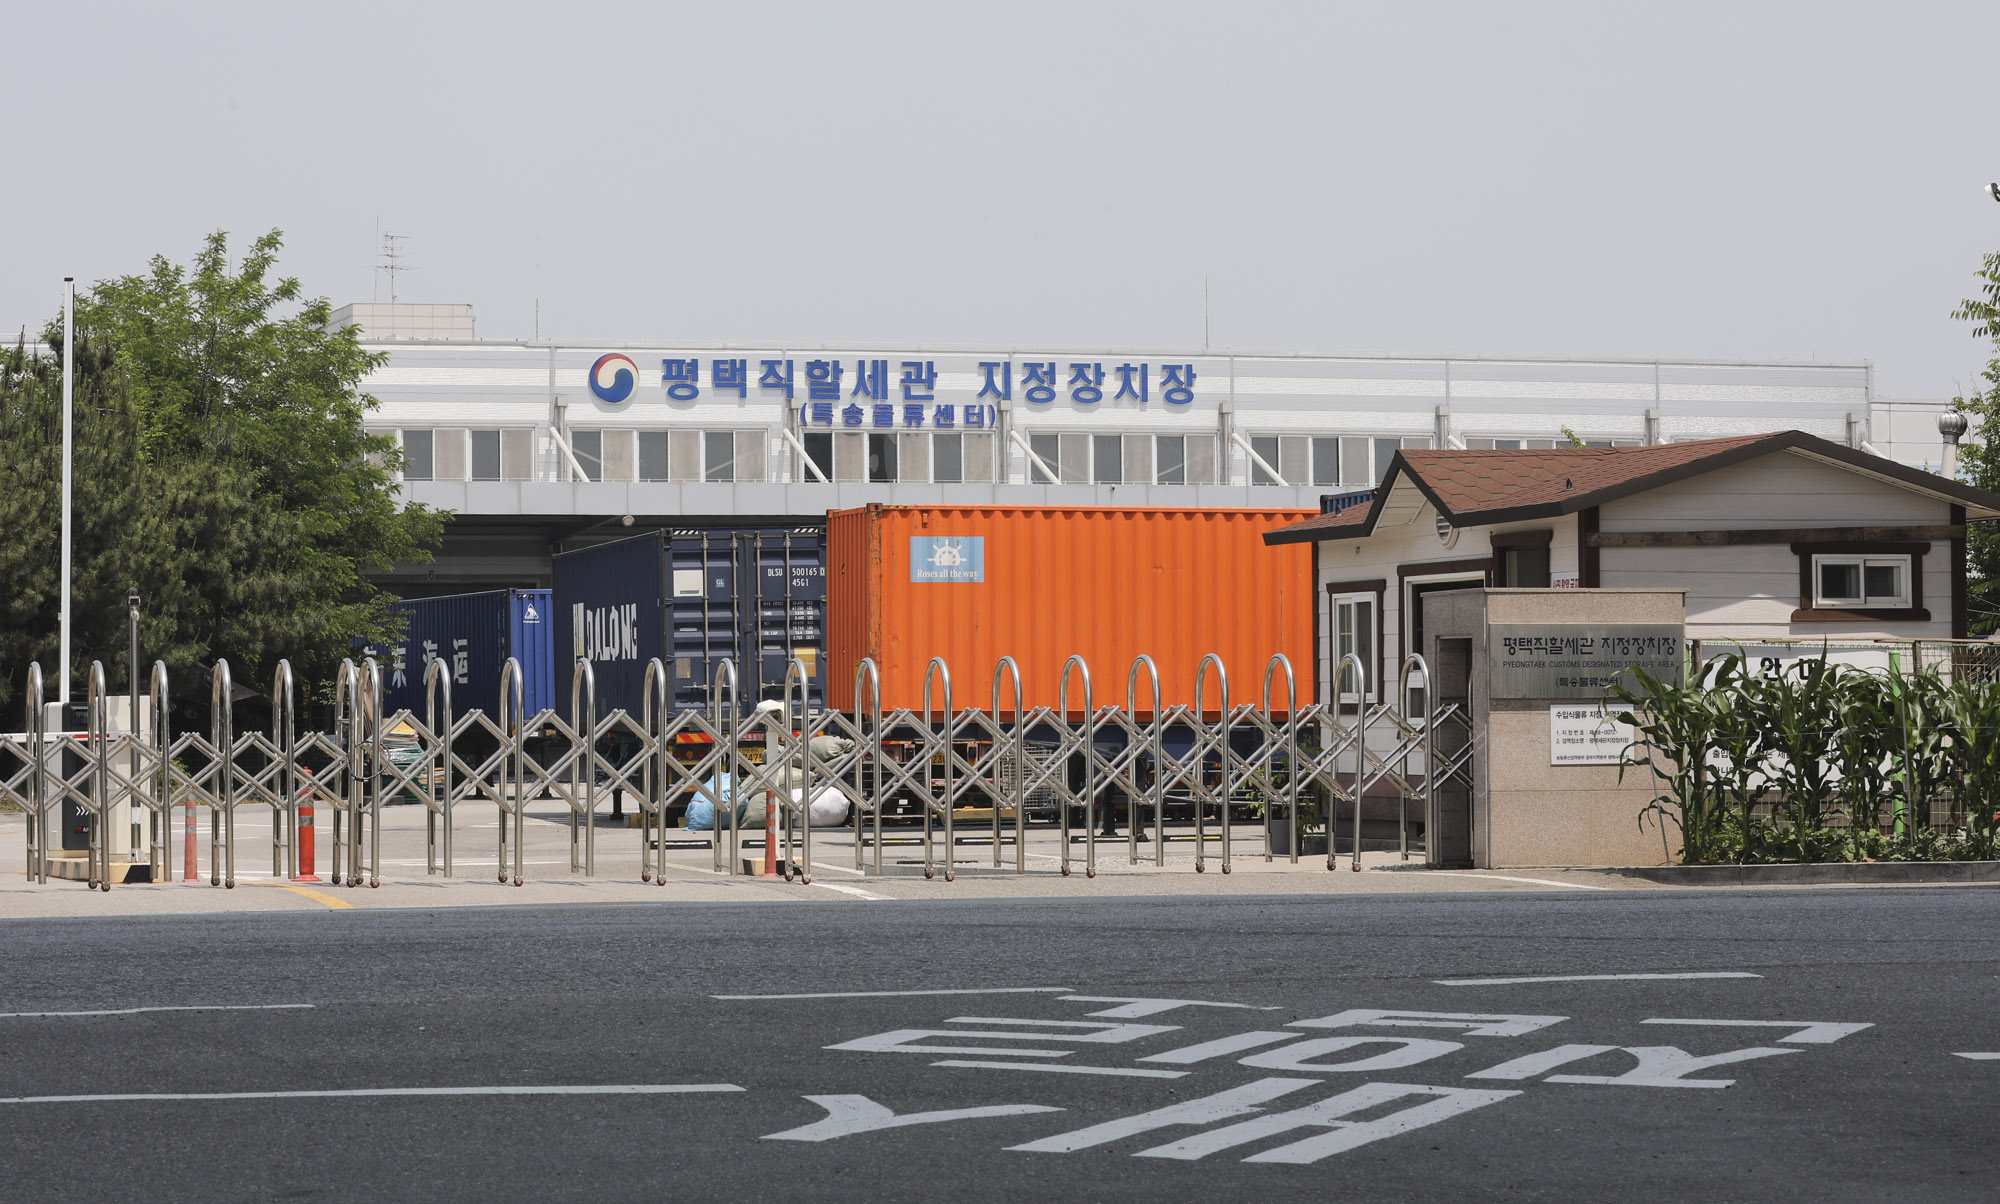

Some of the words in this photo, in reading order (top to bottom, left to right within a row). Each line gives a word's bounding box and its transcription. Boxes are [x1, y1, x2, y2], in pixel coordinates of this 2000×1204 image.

[662, 358, 937, 401] 평택직할세관
[978, 360, 1197, 404] 지정장치장
[801, 402, 996, 428] (특송물류센터)
[428, 570, 436, 579] 6
[767, 568, 783, 576] DLSU
[792, 567, 818, 576] 500165
[917, 568, 938, 578] Roses
[939, 568, 948, 578] all
[950, 568, 963, 578] the
[963, 570, 978, 580] way
[792, 578, 809, 587] 45G1
[1503, 637, 1594, 656] 평택직할세관
[1601, 636, 1677, 656] 지정장치장
[1556, 676, 1622, 688] (특송물류센터)
[1556, 710, 1587, 719] 수입식물류
